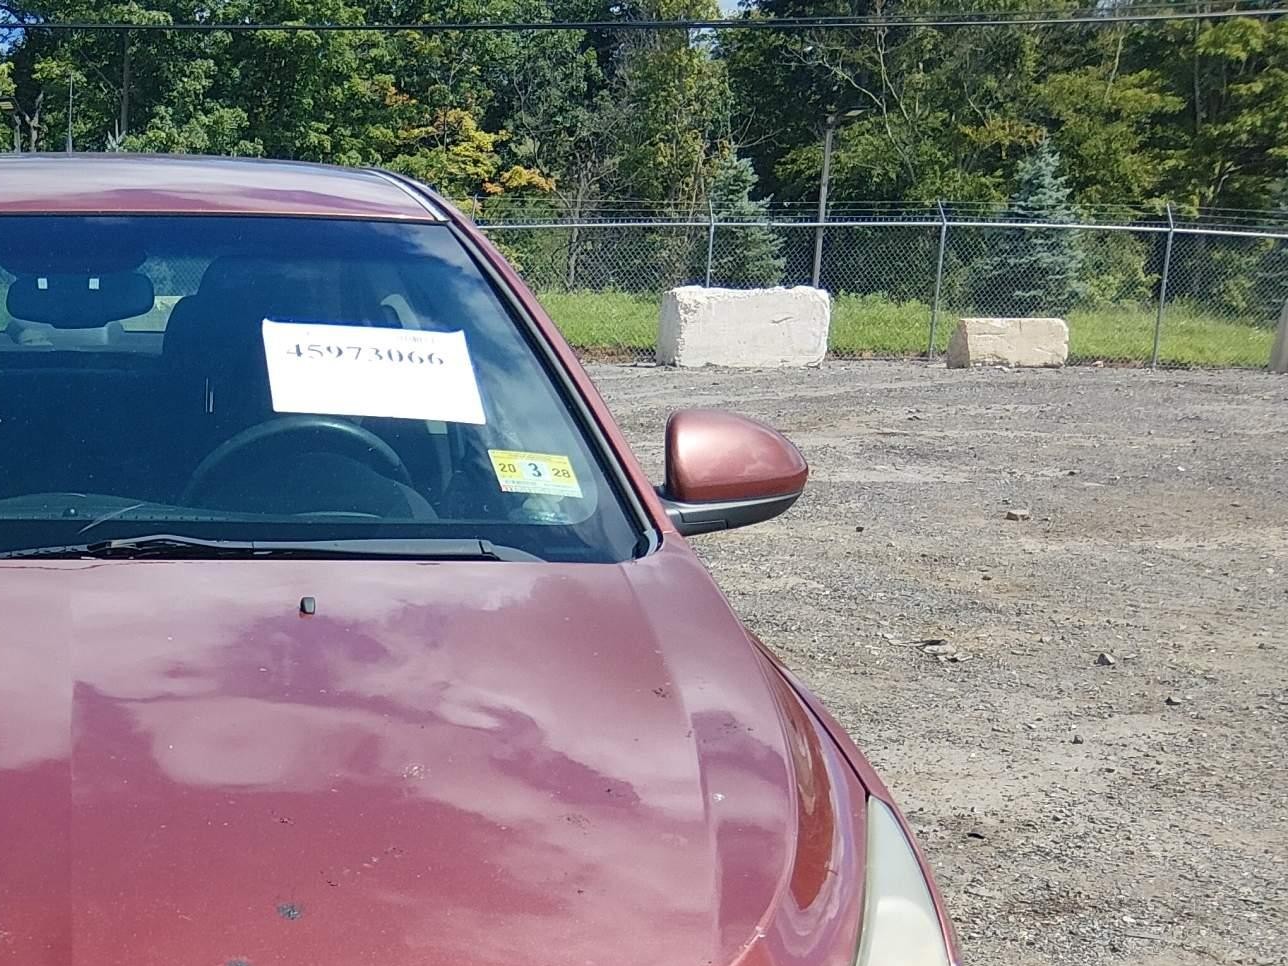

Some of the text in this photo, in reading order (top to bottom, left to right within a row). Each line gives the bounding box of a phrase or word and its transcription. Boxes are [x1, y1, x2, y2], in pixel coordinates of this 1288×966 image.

[285, 343, 445, 366] 45973066
[498, 462, 571, 479] 20 3 28
